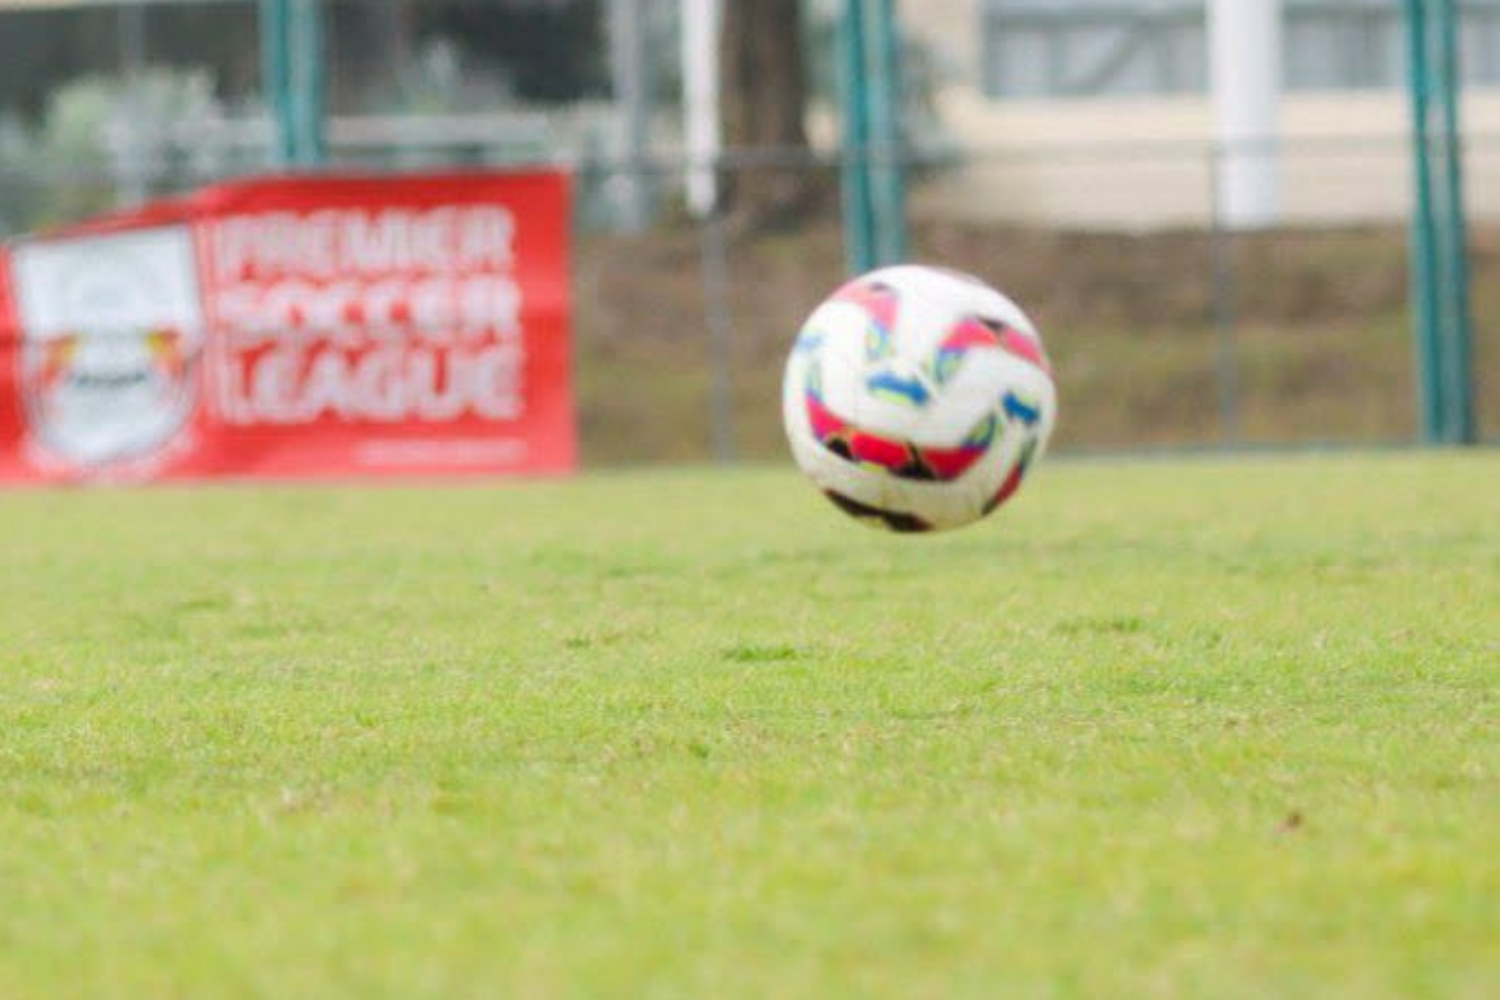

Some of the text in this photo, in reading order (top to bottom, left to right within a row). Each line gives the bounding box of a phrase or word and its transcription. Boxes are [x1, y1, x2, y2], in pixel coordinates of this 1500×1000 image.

[216, 205, 516, 275] PREMIER
[216, 273, 522, 340] SOCCER
[218, 335, 523, 424] LEAGUE
